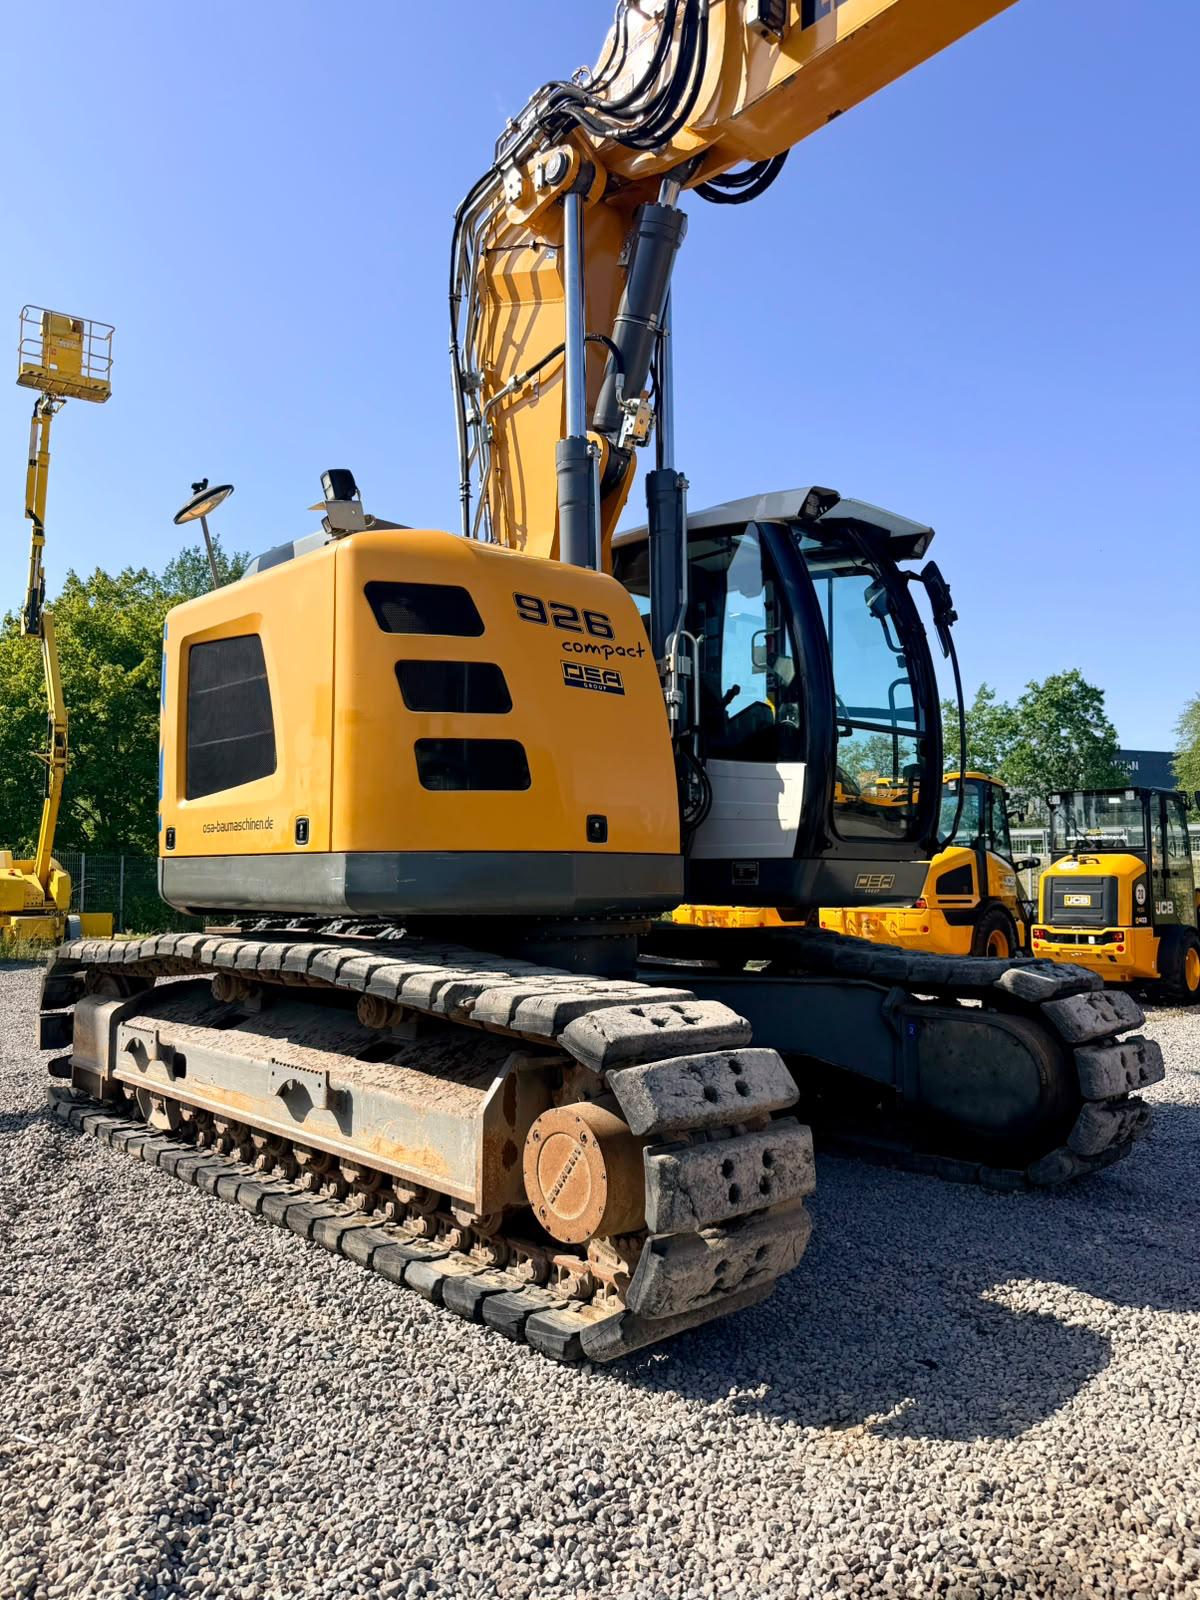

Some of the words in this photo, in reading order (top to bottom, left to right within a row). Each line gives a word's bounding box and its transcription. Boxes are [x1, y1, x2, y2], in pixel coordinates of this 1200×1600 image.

[512, 592, 615, 641] 926
[562, 641, 646, 660] compact
[583, 682, 607, 691] GROUP
[202, 816, 274, 834] osa-baumaschinen.de
[1064, 896, 1089, 905] JCB
[1155, 901, 1174, 915] JCB
